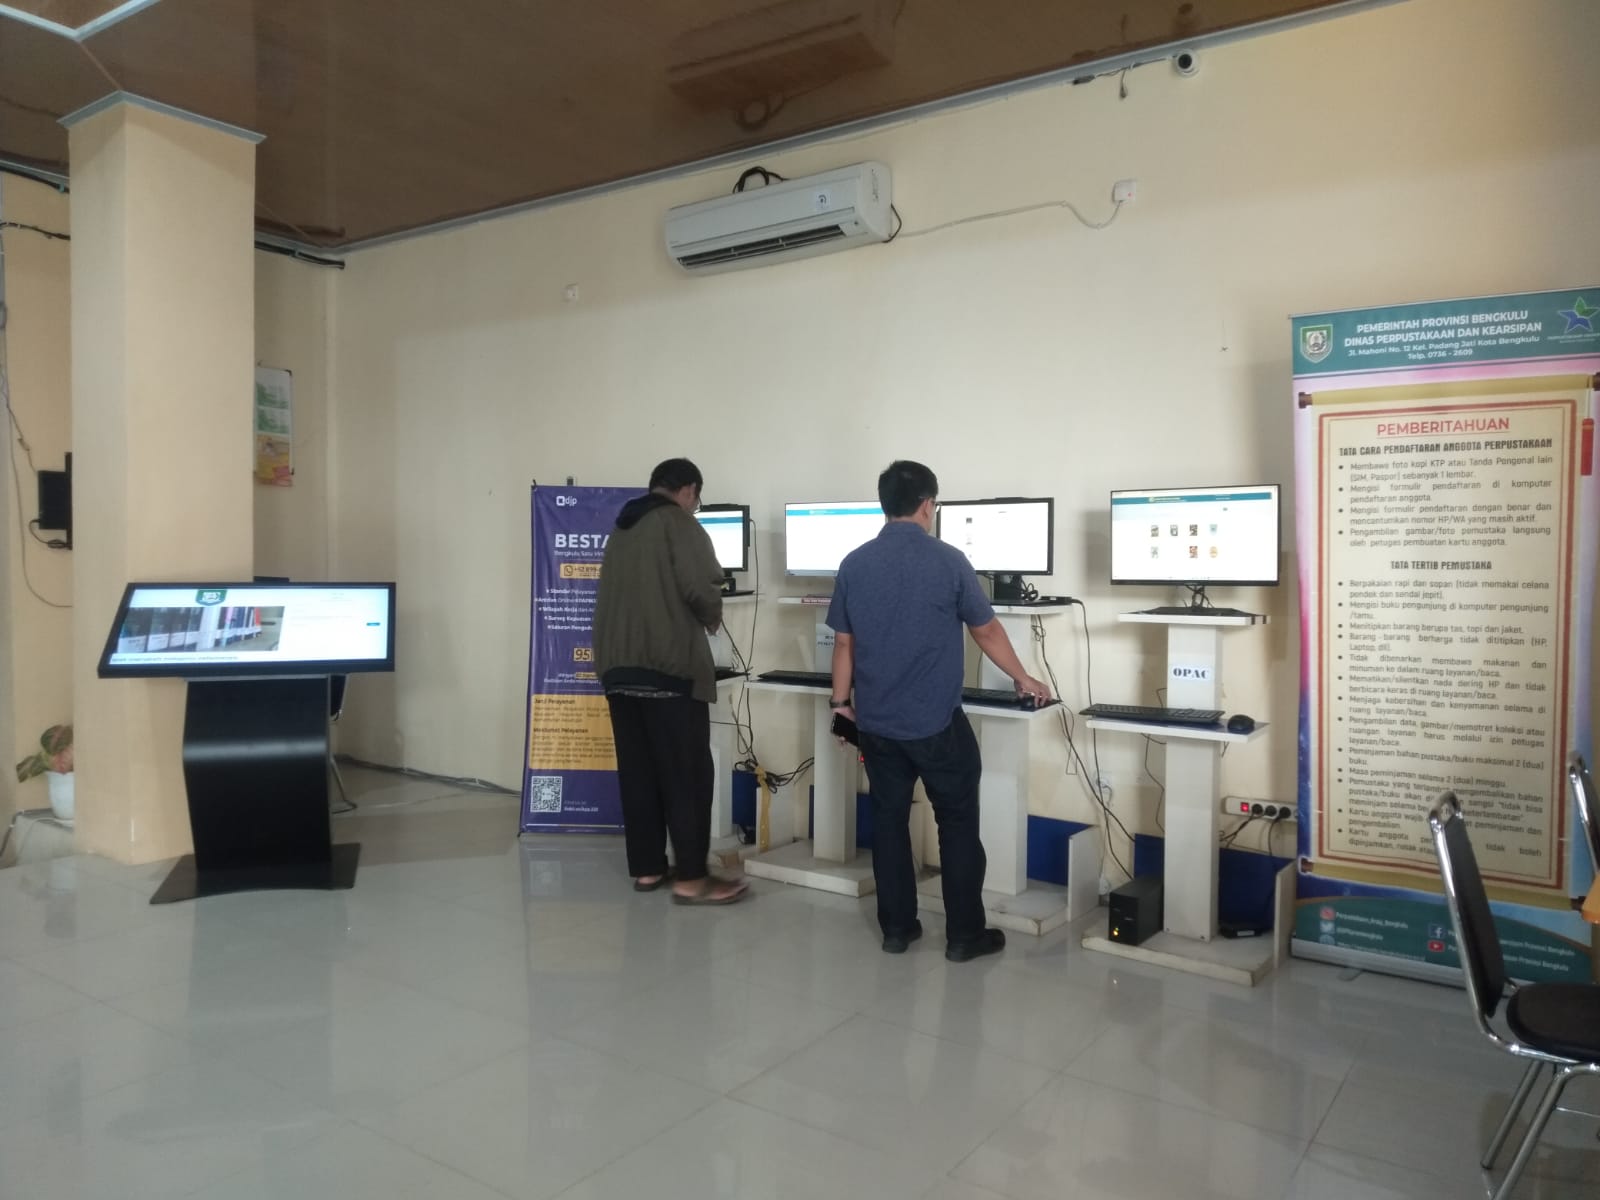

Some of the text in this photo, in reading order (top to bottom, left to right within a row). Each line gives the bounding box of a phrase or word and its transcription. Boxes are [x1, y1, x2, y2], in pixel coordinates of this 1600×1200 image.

[1357, 310, 1528, 333] PEMERINTAH PROVINSI BENGKULU
[1344, 335, 1374, 347] DINAS
[1376, 329, 1454, 344] PERPUSTAKAAN
[1457, 327, 1480, 338] DAN
[1482, 322, 1542, 336] KEARSIPAN
[1358, 347, 1387, 356] Mahoni
[1412, 343, 1427, 351] Kel.
[1428, 341, 1460, 350] Padang
[1460, 339, 1476, 348] Jati
[1478, 338, 1497, 347] Kota
[1498, 335, 1541, 345] Bengkulu
[1408, 352, 1426, 361] Telp.
[1427, 350, 1447, 359] 0736
[1453, 348, 1473, 356] 2609
[1377, 417, 1510, 436] PEMBERITAHUAN
[1340, 438, 1552, 456] TATA CARA PENDAFTARAN ANGGOTA PERPUSTAKAAN
[1350, 455, 1552, 471] Membawa foto kopi KTP atau Tanda Pengenal lain
[1402, 471, 1438, 480] sebanyak
[1350, 479, 1552, 493] Mengisi formulir pendaftaran di komputer
[1350, 495, 1397, 504] pendaftaran
[1350, 502, 1552, 515] Mengisi formulir pendaftaran dengan benar dan
[1411, 516, 1435, 524] nomor
[1438, 515, 1465, 524] HP/WA
[1467, 515, 1487, 525] yang
[1489, 514, 1514, 523] masih
[1405, 526, 1455, 536] gambar/foto
[1461, 526, 1506, 535] pemustaka
[1512, 525, 1551, 535] langsung
[1403, 539, 1447, 548] pembuatan
[1448, 538, 1469, 546] kartu
[1390, 560, 1493, 570] TATA TERTIB PEMUSTAKA
[1394, 580, 1410, 589] rapi
[1412, 579, 1427, 588] dan
[1429, 581, 1453, 589] sopan
[1481, 580, 1519, 589] memakai
[1521, 581, 1549, 590] celana
[1402, 602, 1447, 611] pengunjung
[1449, 602, 1456, 610] di
[1459, 602, 1497, 611] komputer
[1500, 603, 1549, 614] pengunjung
[1393, 622, 1420, 632] barang
[1421, 623, 1448, 633] berupa
[1467, 625, 1482, 634] topi
[1484, 625, 1499, 633] dan
[1460, 635, 1479, 644] tidak
[1486, 635, 1525, 646] dititipkan
[1349, 653, 1368, 661] Tidak
[1483, 658, 1520, 667] makanan
[1531, 660, 1547, 669] dan
[1172, 667, 1210, 681] OPAC
[1421, 667, 1444, 677] ruang
[1457, 680, 1483, 689] dering
[1505, 681, 1520, 689] dan
[1525, 681, 1546, 691] tidak
[1418, 688, 1440, 698] ruang
[1430, 700, 1445, 708] dan
[1449, 702, 1499, 711] kenyamanan
[1504, 703, 1533, 713] selama
[1538, 705, 1546, 714] di
[1526, 727, 1545, 737] atau
[1511, 737, 1545, 748] petugas
